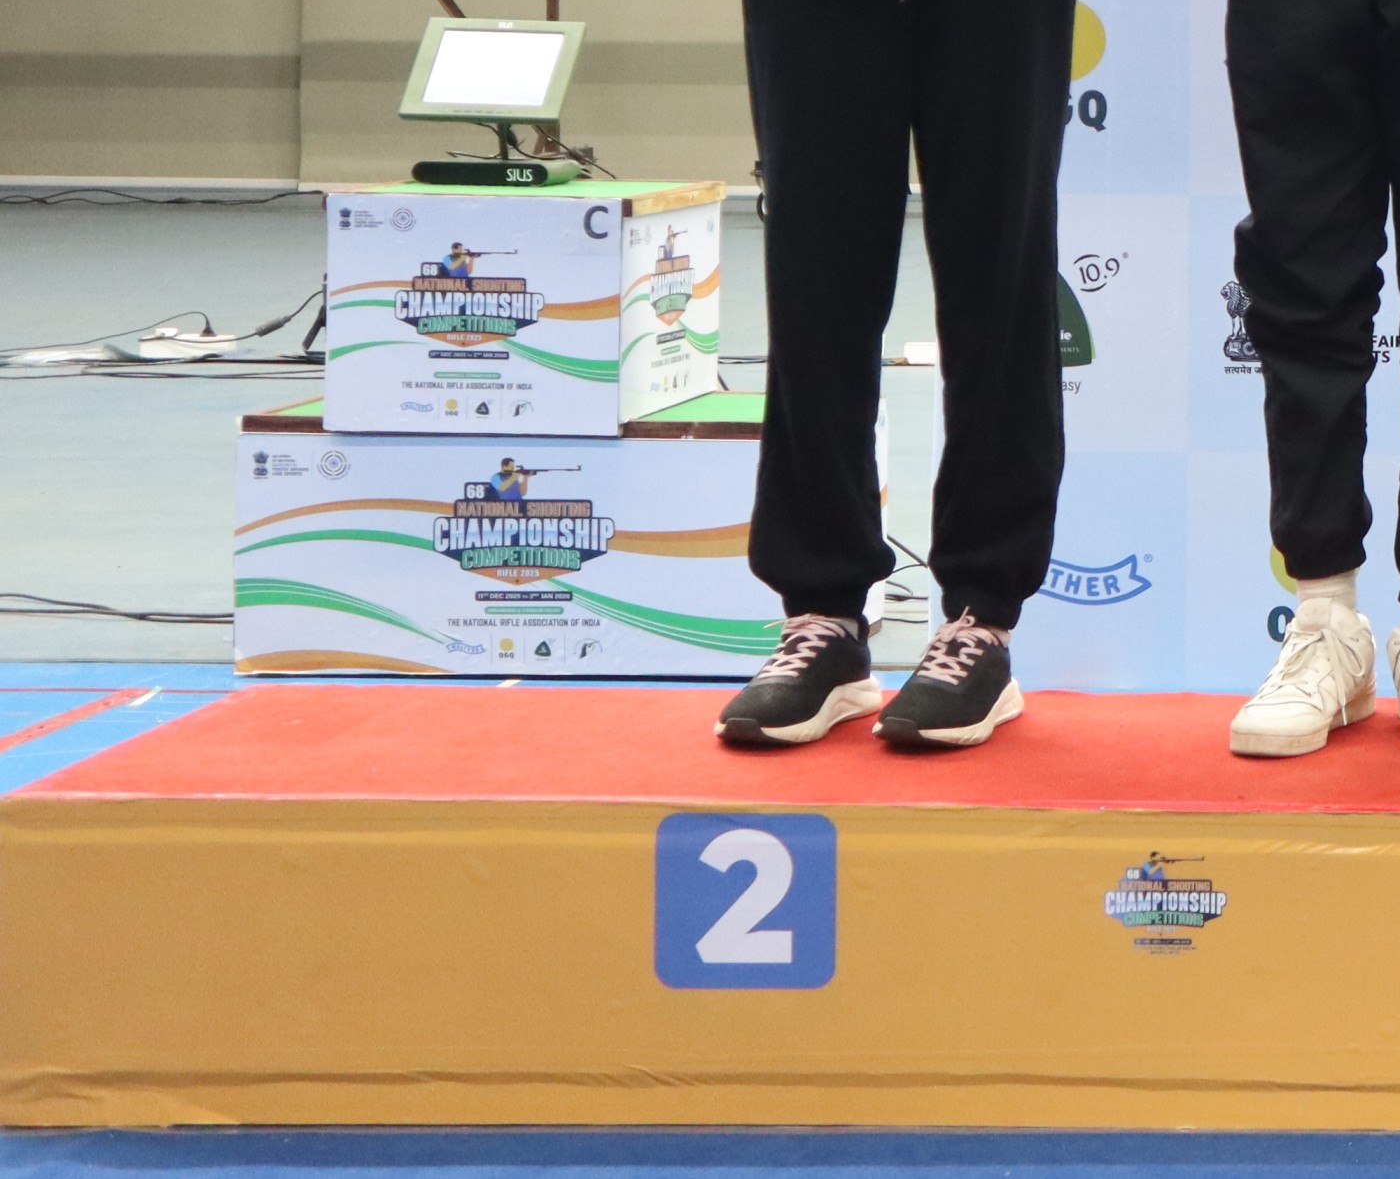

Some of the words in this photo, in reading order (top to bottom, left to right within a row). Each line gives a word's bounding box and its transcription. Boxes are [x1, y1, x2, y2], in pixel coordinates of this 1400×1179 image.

[506, 167, 534, 182] SIUS
[583, 205, 608, 239] C
[1079, 256, 1120, 285] 10.9
[396, 291, 544, 319] CHAMPIONSHIP
[419, 318, 516, 334] COMPETITIONS
[456, 502, 522, 516] NATIONAL
[527, 502, 590, 517] SHOOTING
[434, 518, 615, 551] CHAMPIONSHIP
[462, 548, 580, 569] COMPETITIONS
[497, 569, 517, 577] RIFLE
[695, 828, 793, 964] 2
[1105, 892, 1226, 915] CHAMPIONSHIP
